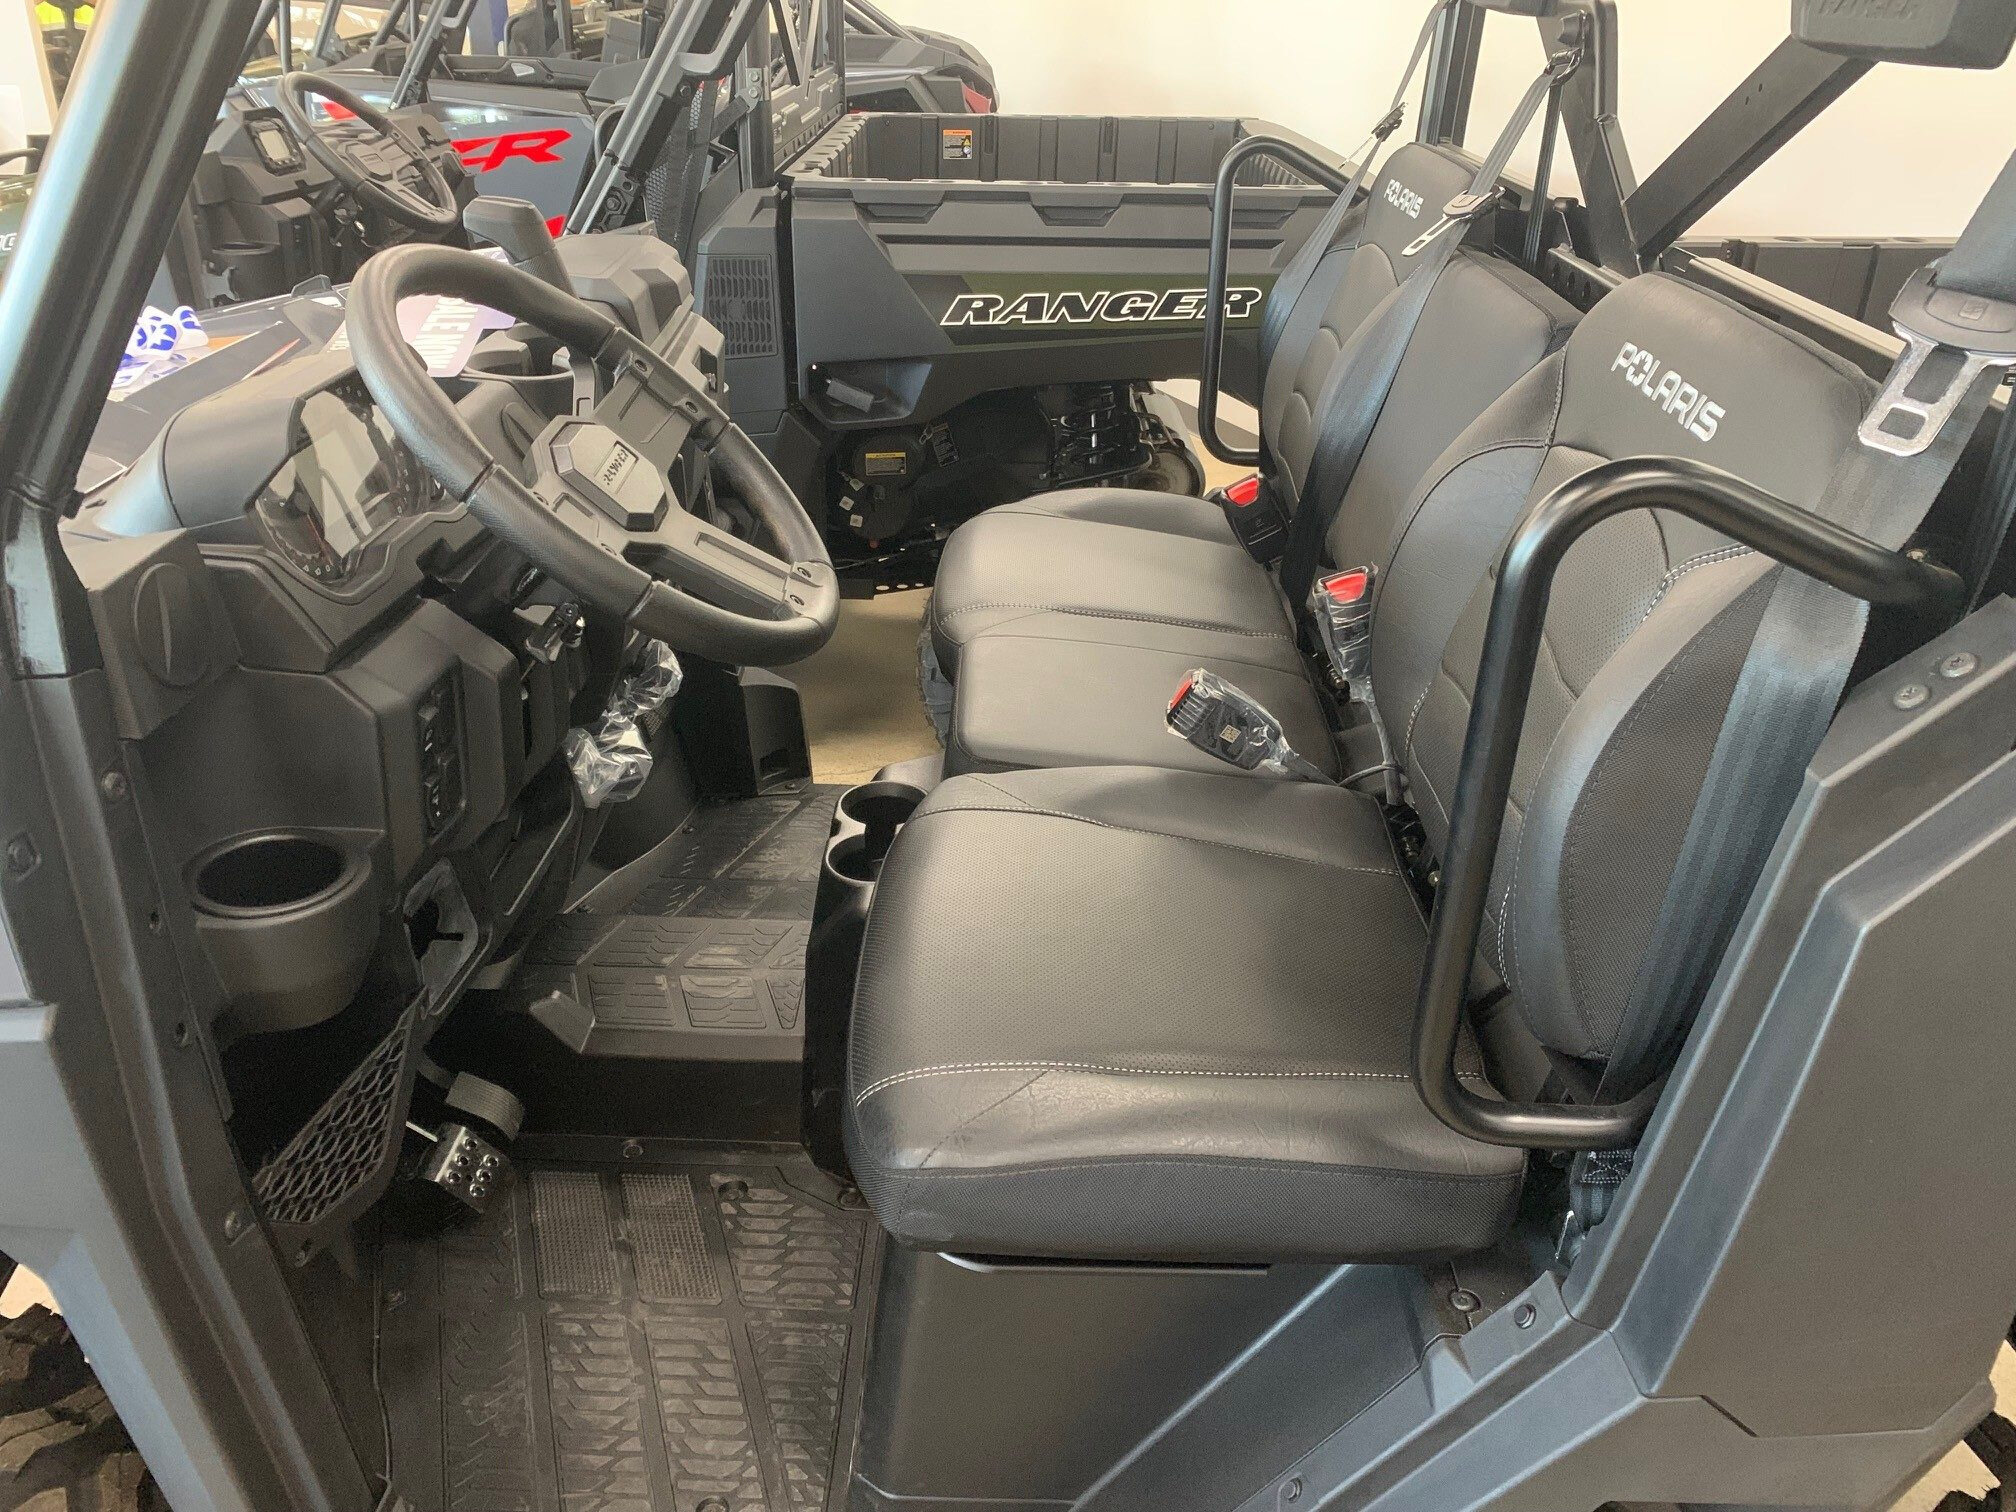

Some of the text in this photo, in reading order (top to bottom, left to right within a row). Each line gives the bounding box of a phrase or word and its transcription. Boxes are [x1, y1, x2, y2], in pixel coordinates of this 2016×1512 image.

[1383, 178, 1425, 219] POLARIS
[940, 287, 1263, 326] RANGER
[1610, 341, 1726, 442] POLARIS
